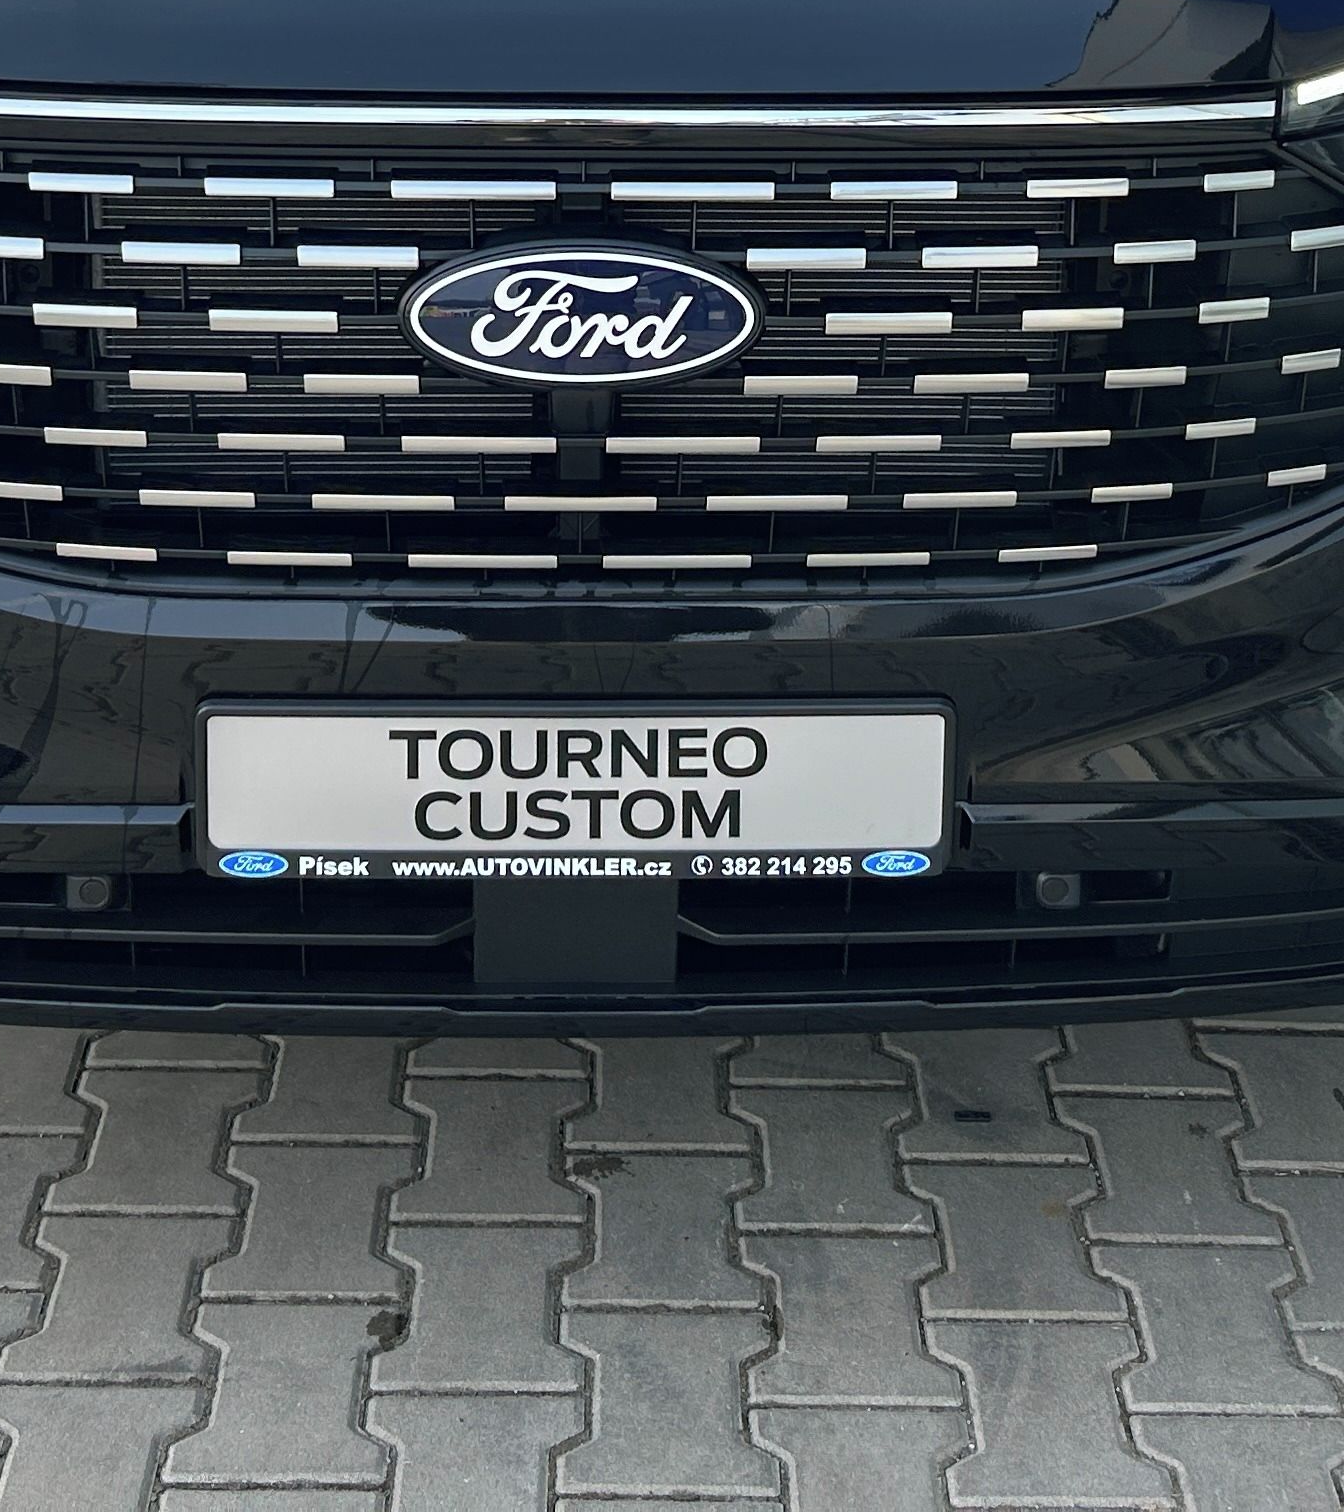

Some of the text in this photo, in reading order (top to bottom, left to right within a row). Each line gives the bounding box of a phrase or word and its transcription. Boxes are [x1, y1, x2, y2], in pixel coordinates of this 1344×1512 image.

[469, 269, 694, 360] Ford
[388, 727, 769, 780] TOURNEO
[414, 789, 743, 841] CUSTOM
[298, 855, 370, 876] Písek
[392, 857, 672, 876] www.AUTOVINKLER.cz
[721, 857, 761, 876] 382
[766, 857, 807, 875] 214
[812, 856, 853, 875] 295
